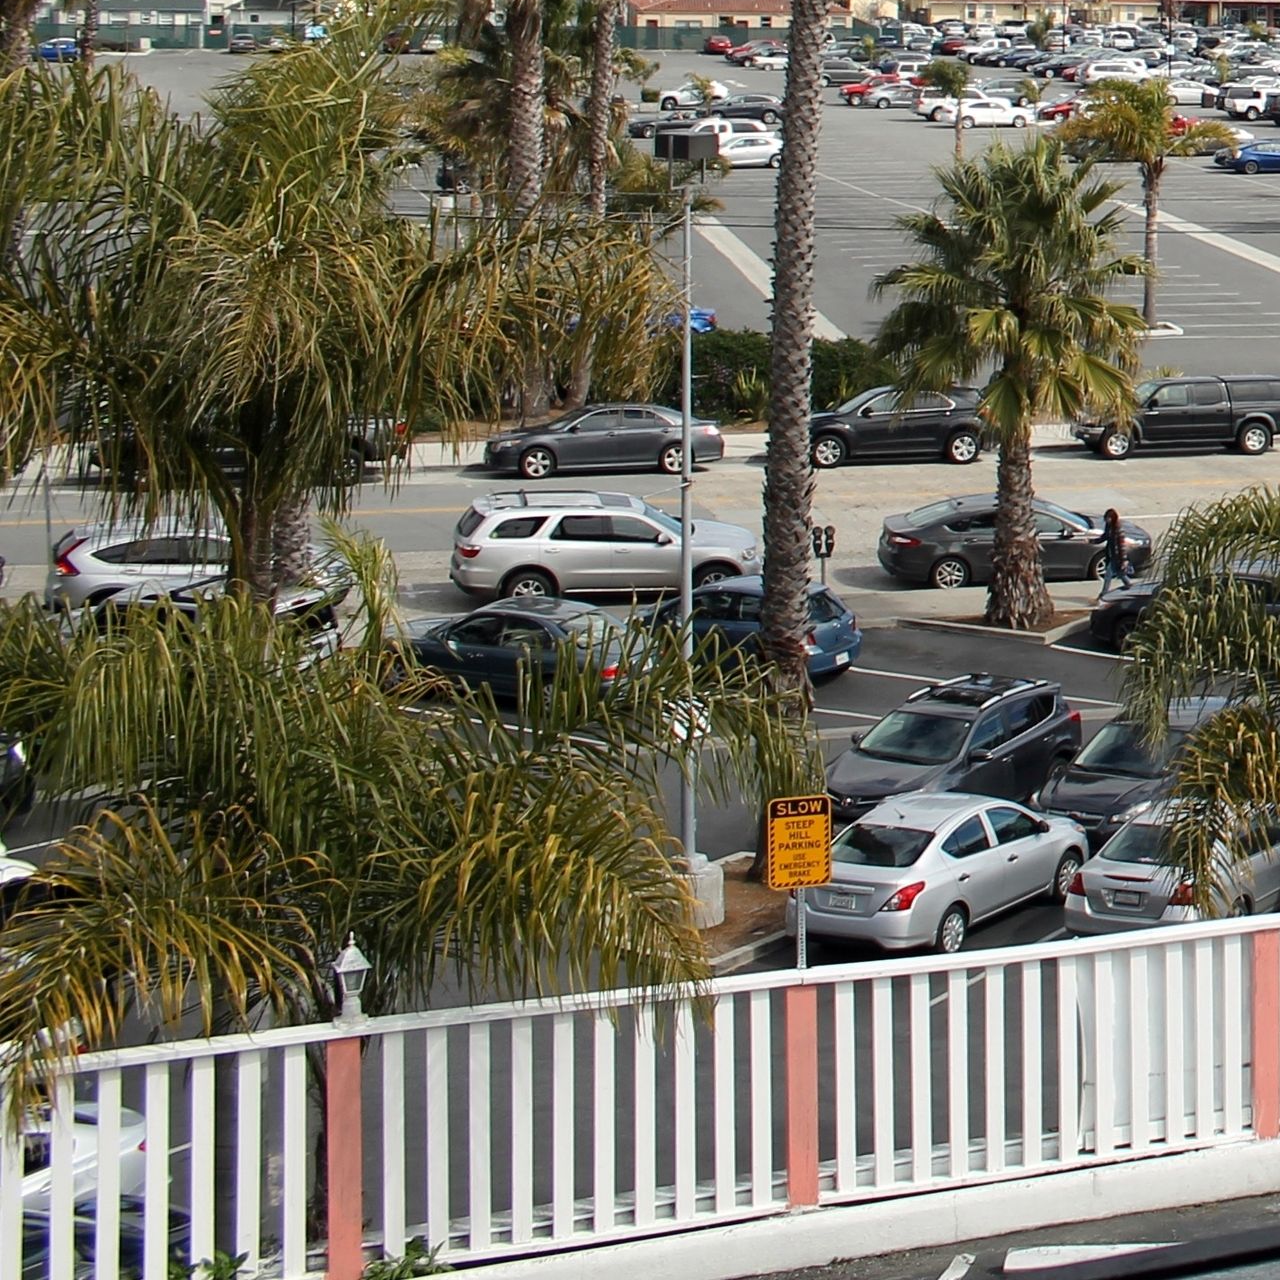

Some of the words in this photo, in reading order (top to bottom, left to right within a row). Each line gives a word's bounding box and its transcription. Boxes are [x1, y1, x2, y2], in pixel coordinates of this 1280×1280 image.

[776, 800, 822, 816] SLOW
[784, 819, 815, 830] STEEP
[788, 830, 811, 841] HILL
[778, 840, 821, 851] PARKING
[779, 861, 820, 871] EMERGENCY
[788, 869, 811, 878] BRAKE
